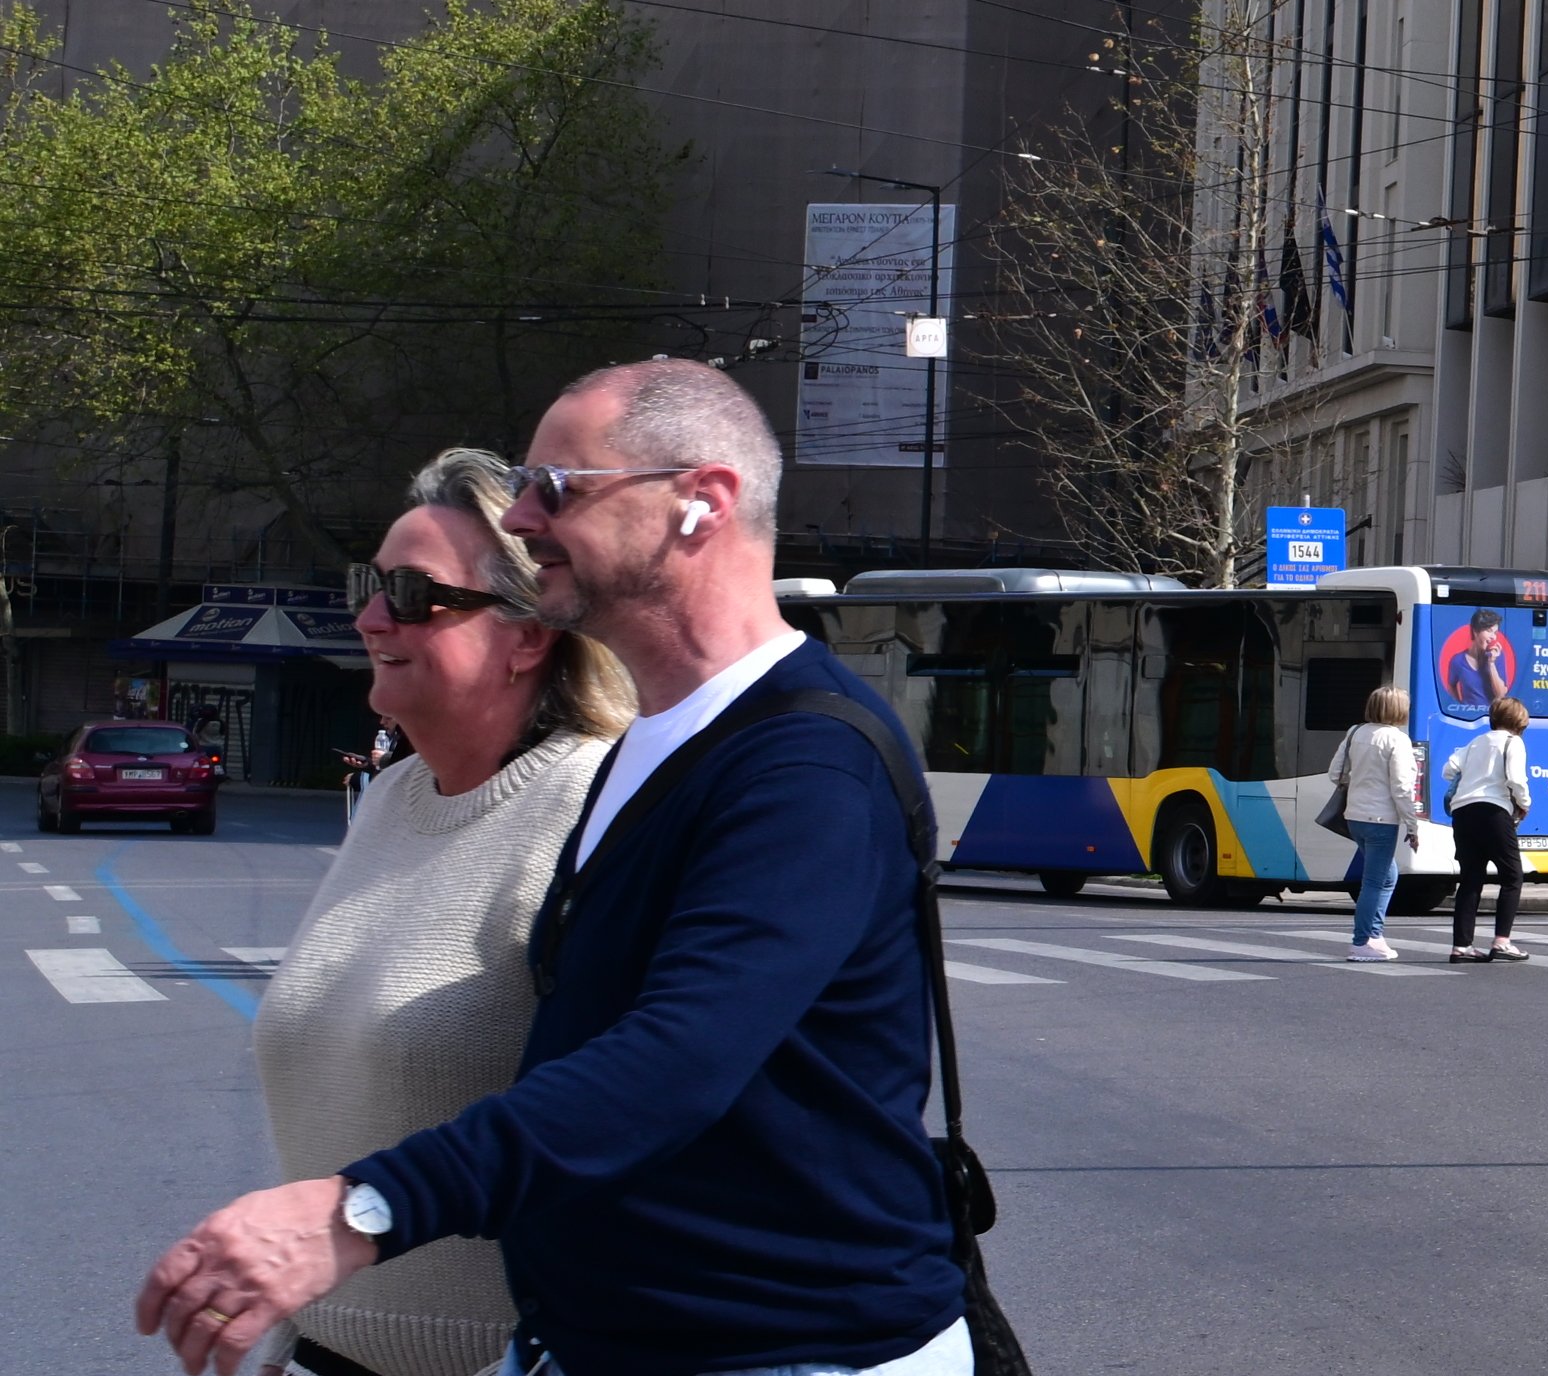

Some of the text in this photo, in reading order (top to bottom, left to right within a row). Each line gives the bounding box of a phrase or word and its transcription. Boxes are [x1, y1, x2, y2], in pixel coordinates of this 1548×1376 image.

[820, 366, 880, 375] PALAIOPANOS
[1292, 544, 1320, 558] 1544
[1522, 581, 1547, 601] 211
[189, 617, 254, 633] motion
[1447, 704, 1491, 712] CITAR
